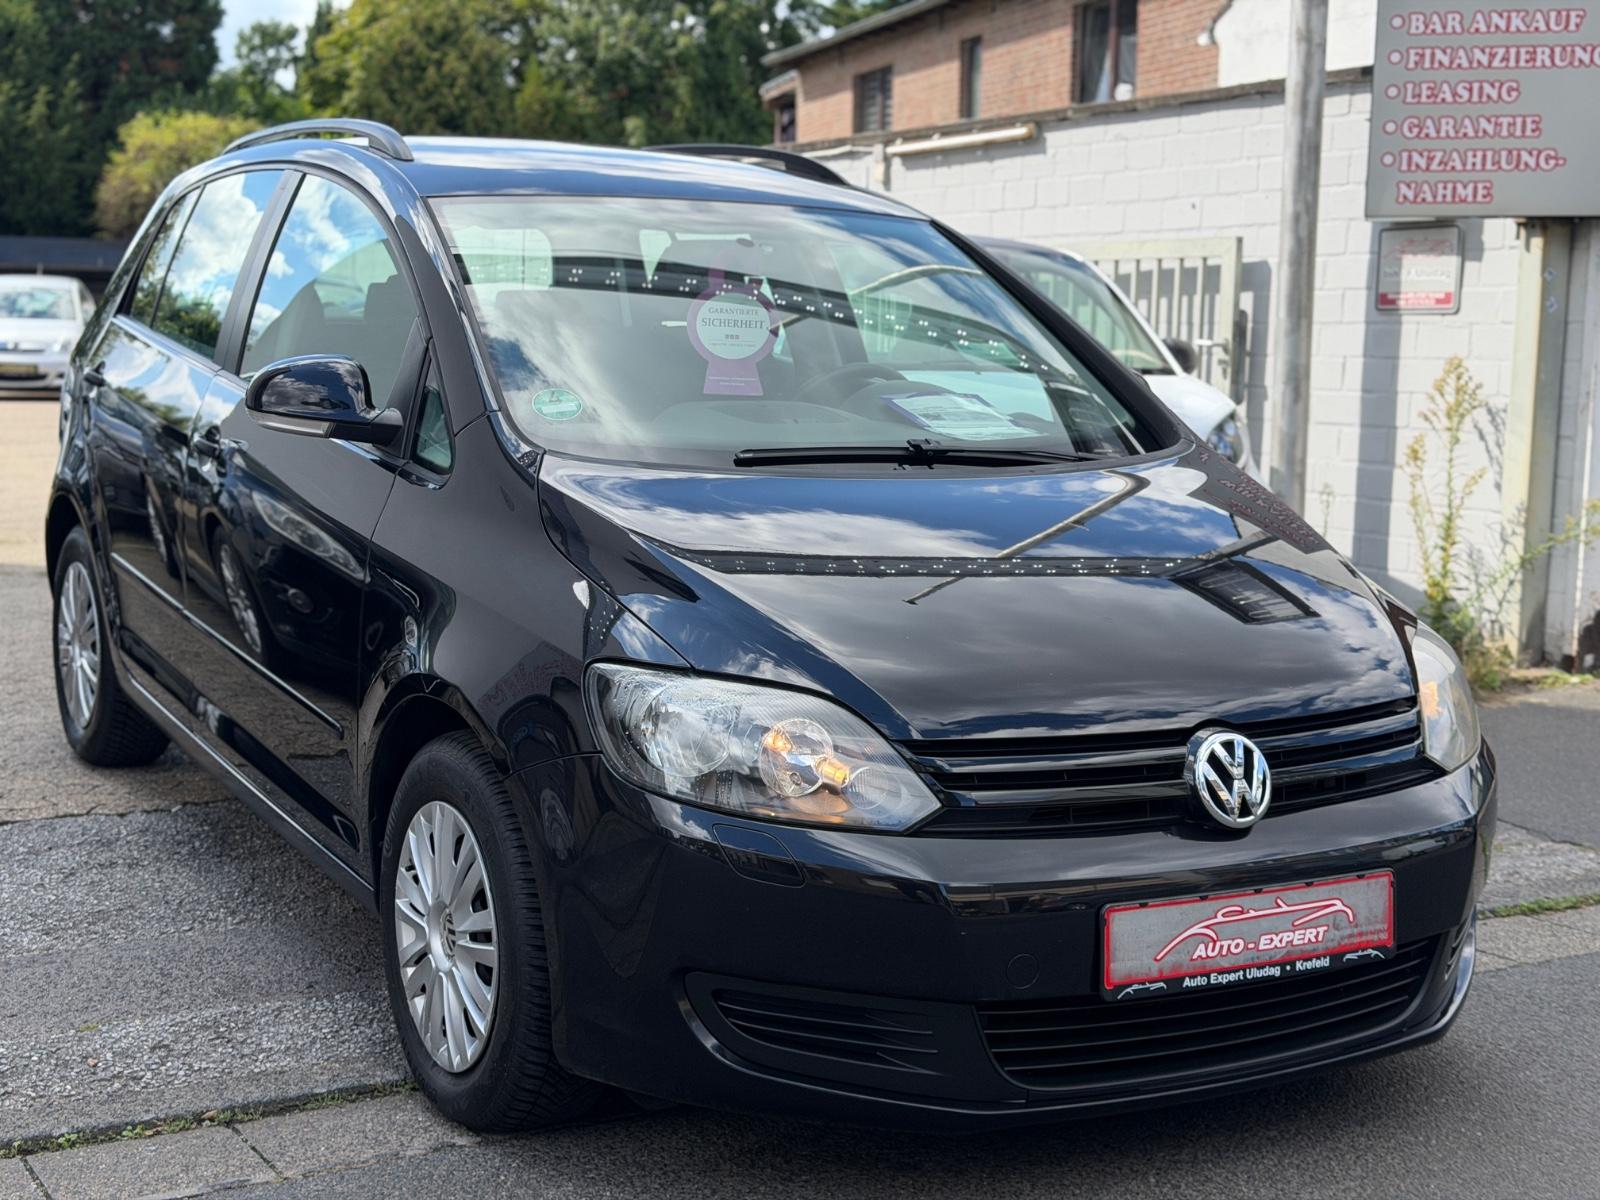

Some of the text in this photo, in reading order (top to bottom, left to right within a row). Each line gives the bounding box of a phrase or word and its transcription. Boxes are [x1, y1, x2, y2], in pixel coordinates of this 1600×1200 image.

[1408, 8, 1586, 35] BAR ANKAUF
[1402, 79, 1520, 104] LEASING
[1401, 114, 1542, 140] GARANTIE
[1398, 148, 1566, 172] INZAHLUNG-
[1396, 180, 1494, 204] NAHME
[701, 317, 765, 330] SICHERHEIT
[1183, 957, 1329, 987] Auto Expert Uludag Krefeld
